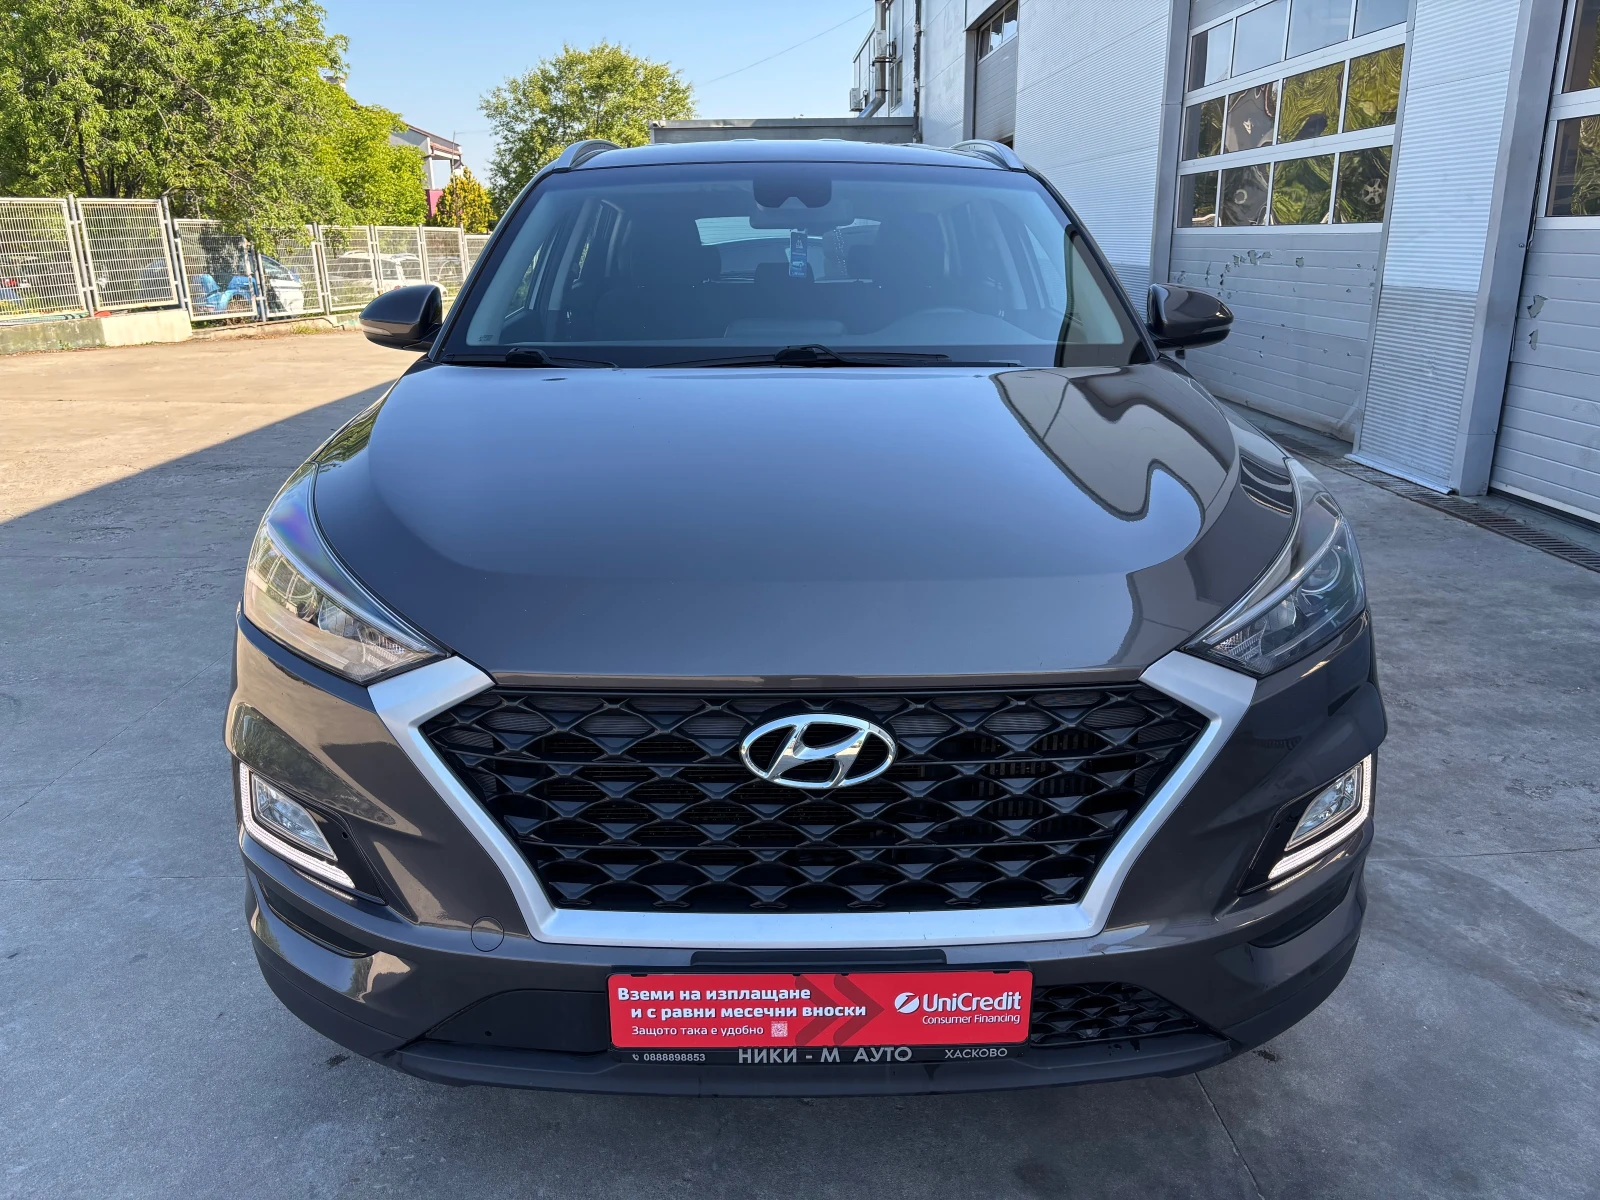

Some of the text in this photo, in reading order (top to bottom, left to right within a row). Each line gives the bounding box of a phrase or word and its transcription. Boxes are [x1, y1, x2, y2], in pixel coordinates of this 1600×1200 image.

[617, 987, 811, 1002] Вземи на изплащане
[922, 991, 1021, 1012] UniCredit
[631, 1006, 866, 1021] и с равни месечни вноски
[922, 1013, 1020, 1025] Consumer Financing
[631, 1025, 764, 1037] Защото така е удобно
[643, 1053, 706, 1062] 0888898853
[738, 1048, 797, 1064] НИКИ
[820, 1047, 841, 1063] М
[853, 1046, 912, 1062] АУТО
[944, 1048, 1008, 1059] ХАСКОВО
